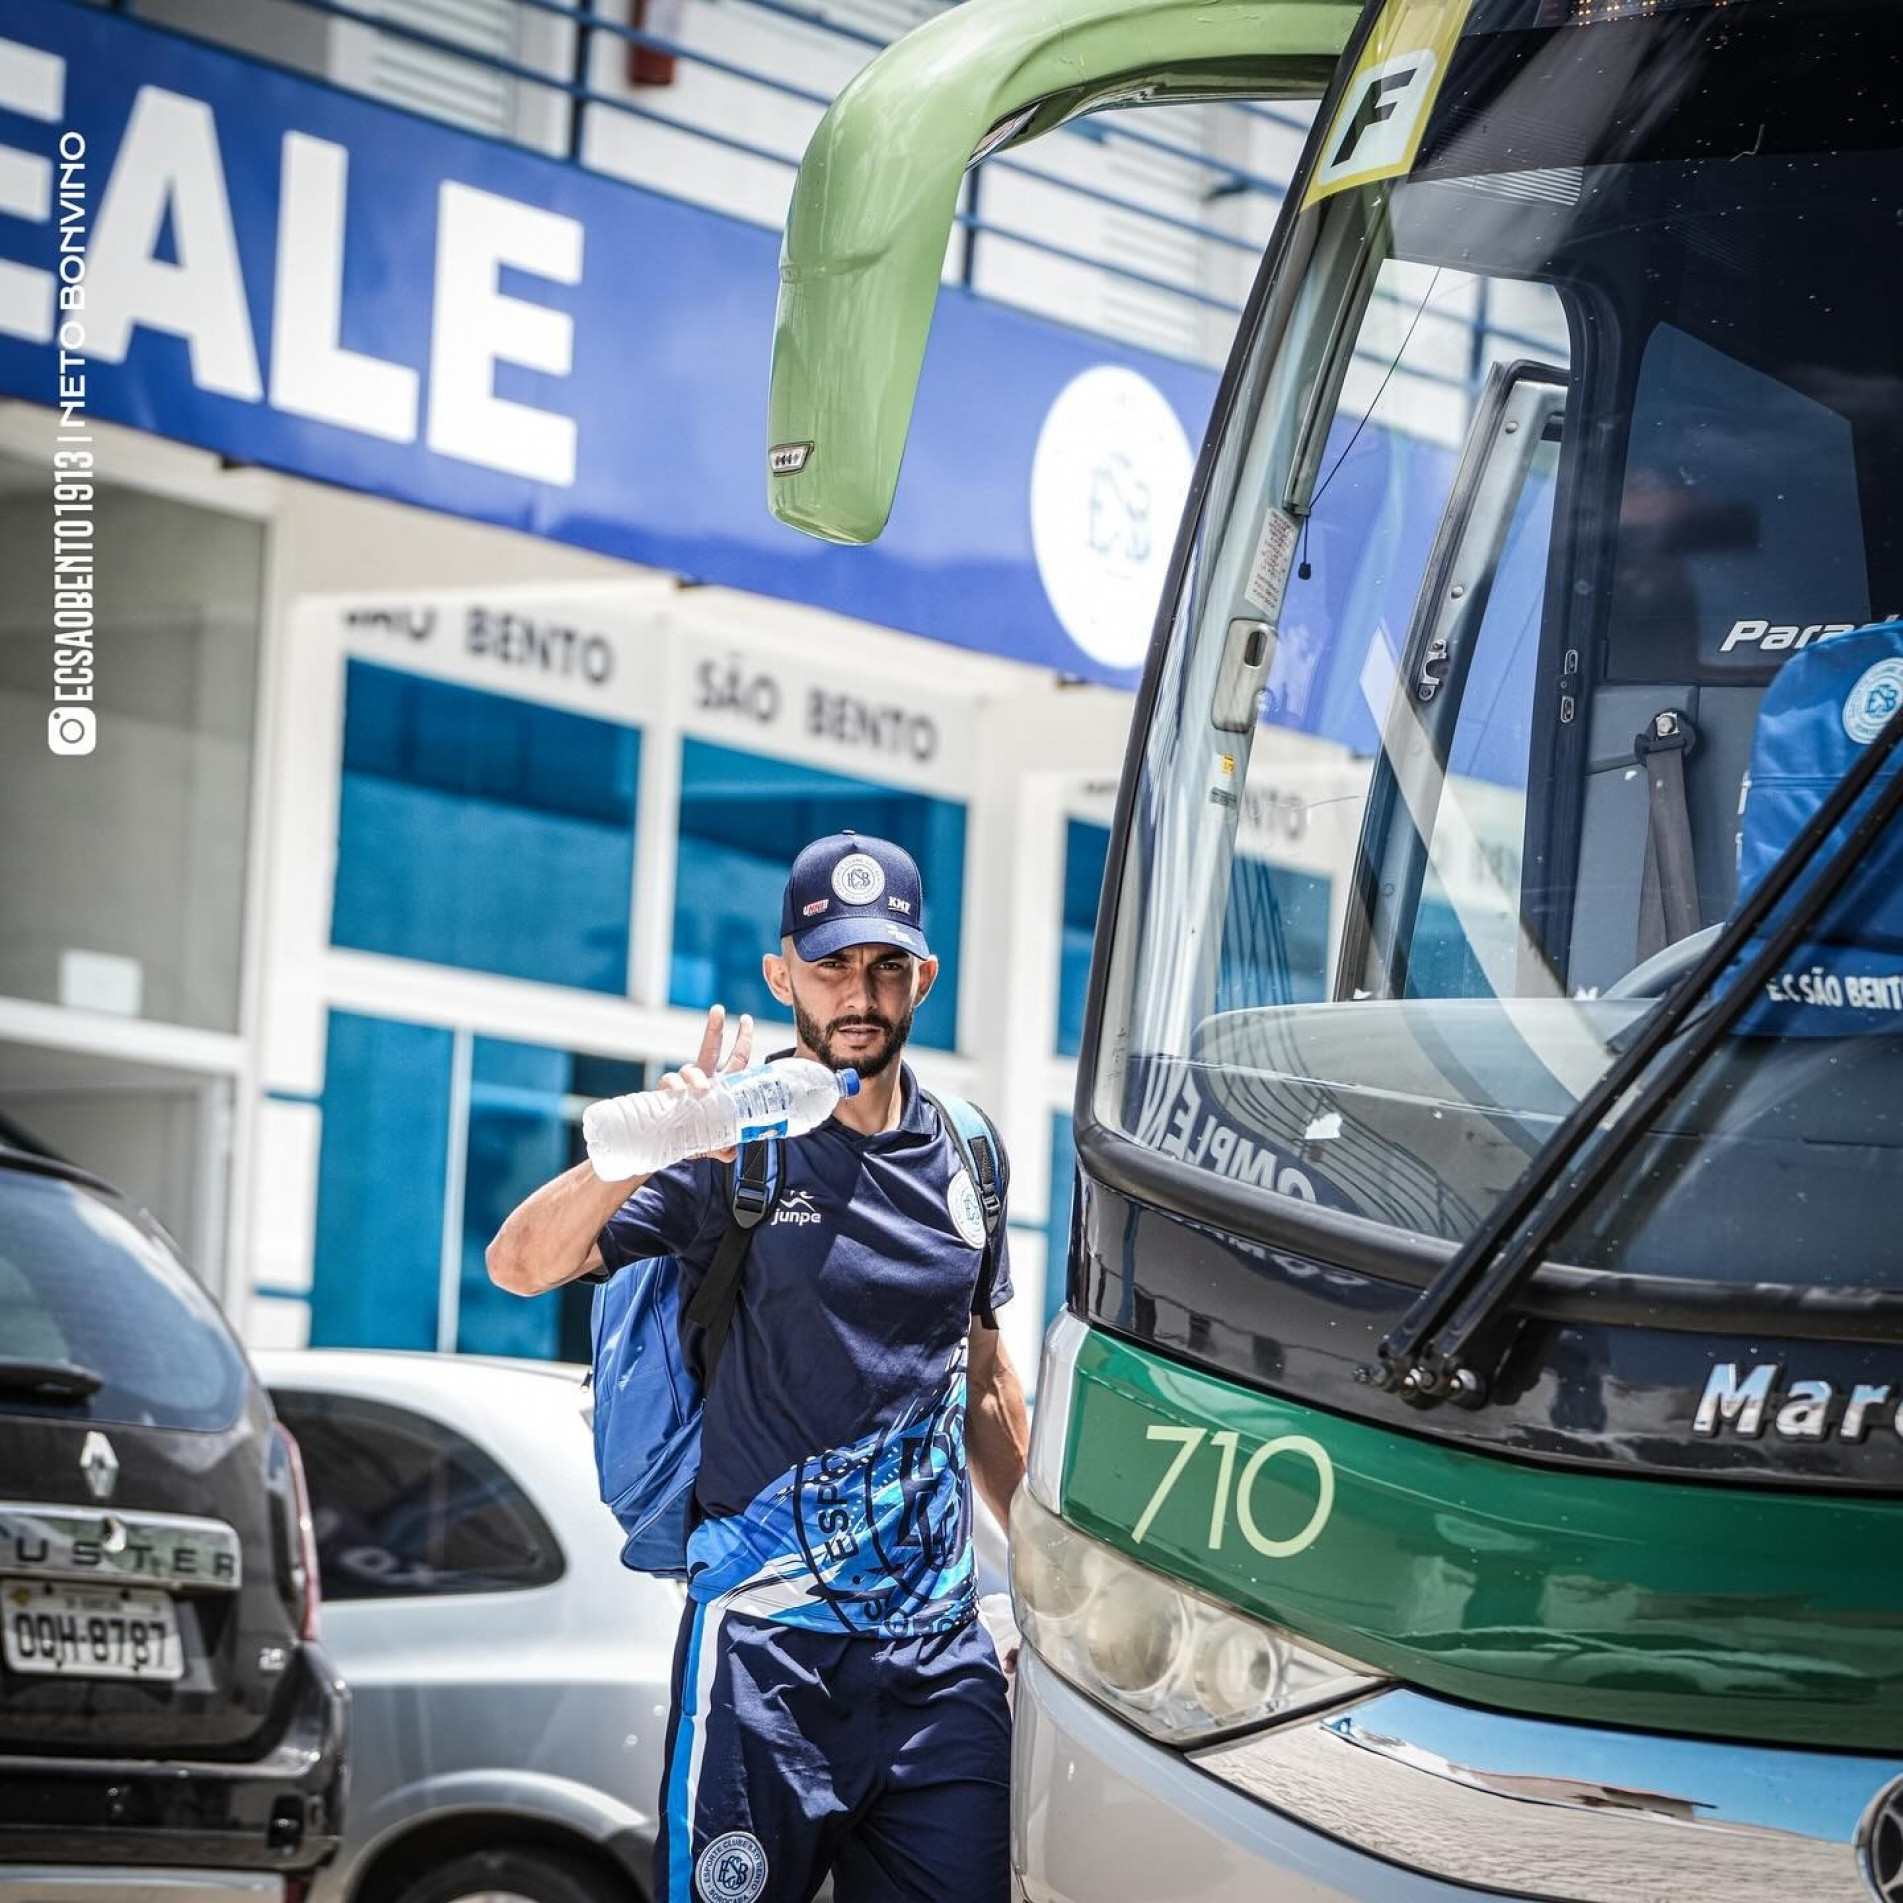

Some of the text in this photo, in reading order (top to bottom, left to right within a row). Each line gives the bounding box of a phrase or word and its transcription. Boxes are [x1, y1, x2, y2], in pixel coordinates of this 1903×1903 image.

[1331, 68, 1417, 168] F
[466, 604, 616, 687] BENTO
[1720, 613, 1899, 652] Para
[697, 651, 940, 762] SÃO BENTO
[1799, 966, 1843, 1008] SÃO
[1844, 975, 1903, 1011] BENT
[770, 1208, 822, 1227] junpe
[1693, 1363, 1903, 1439] Mar
[1131, 1425, 1335, 1558] 710
[16, 1536, 235, 1578] USTER
[703, 1845, 723, 1883] ESPORTE
